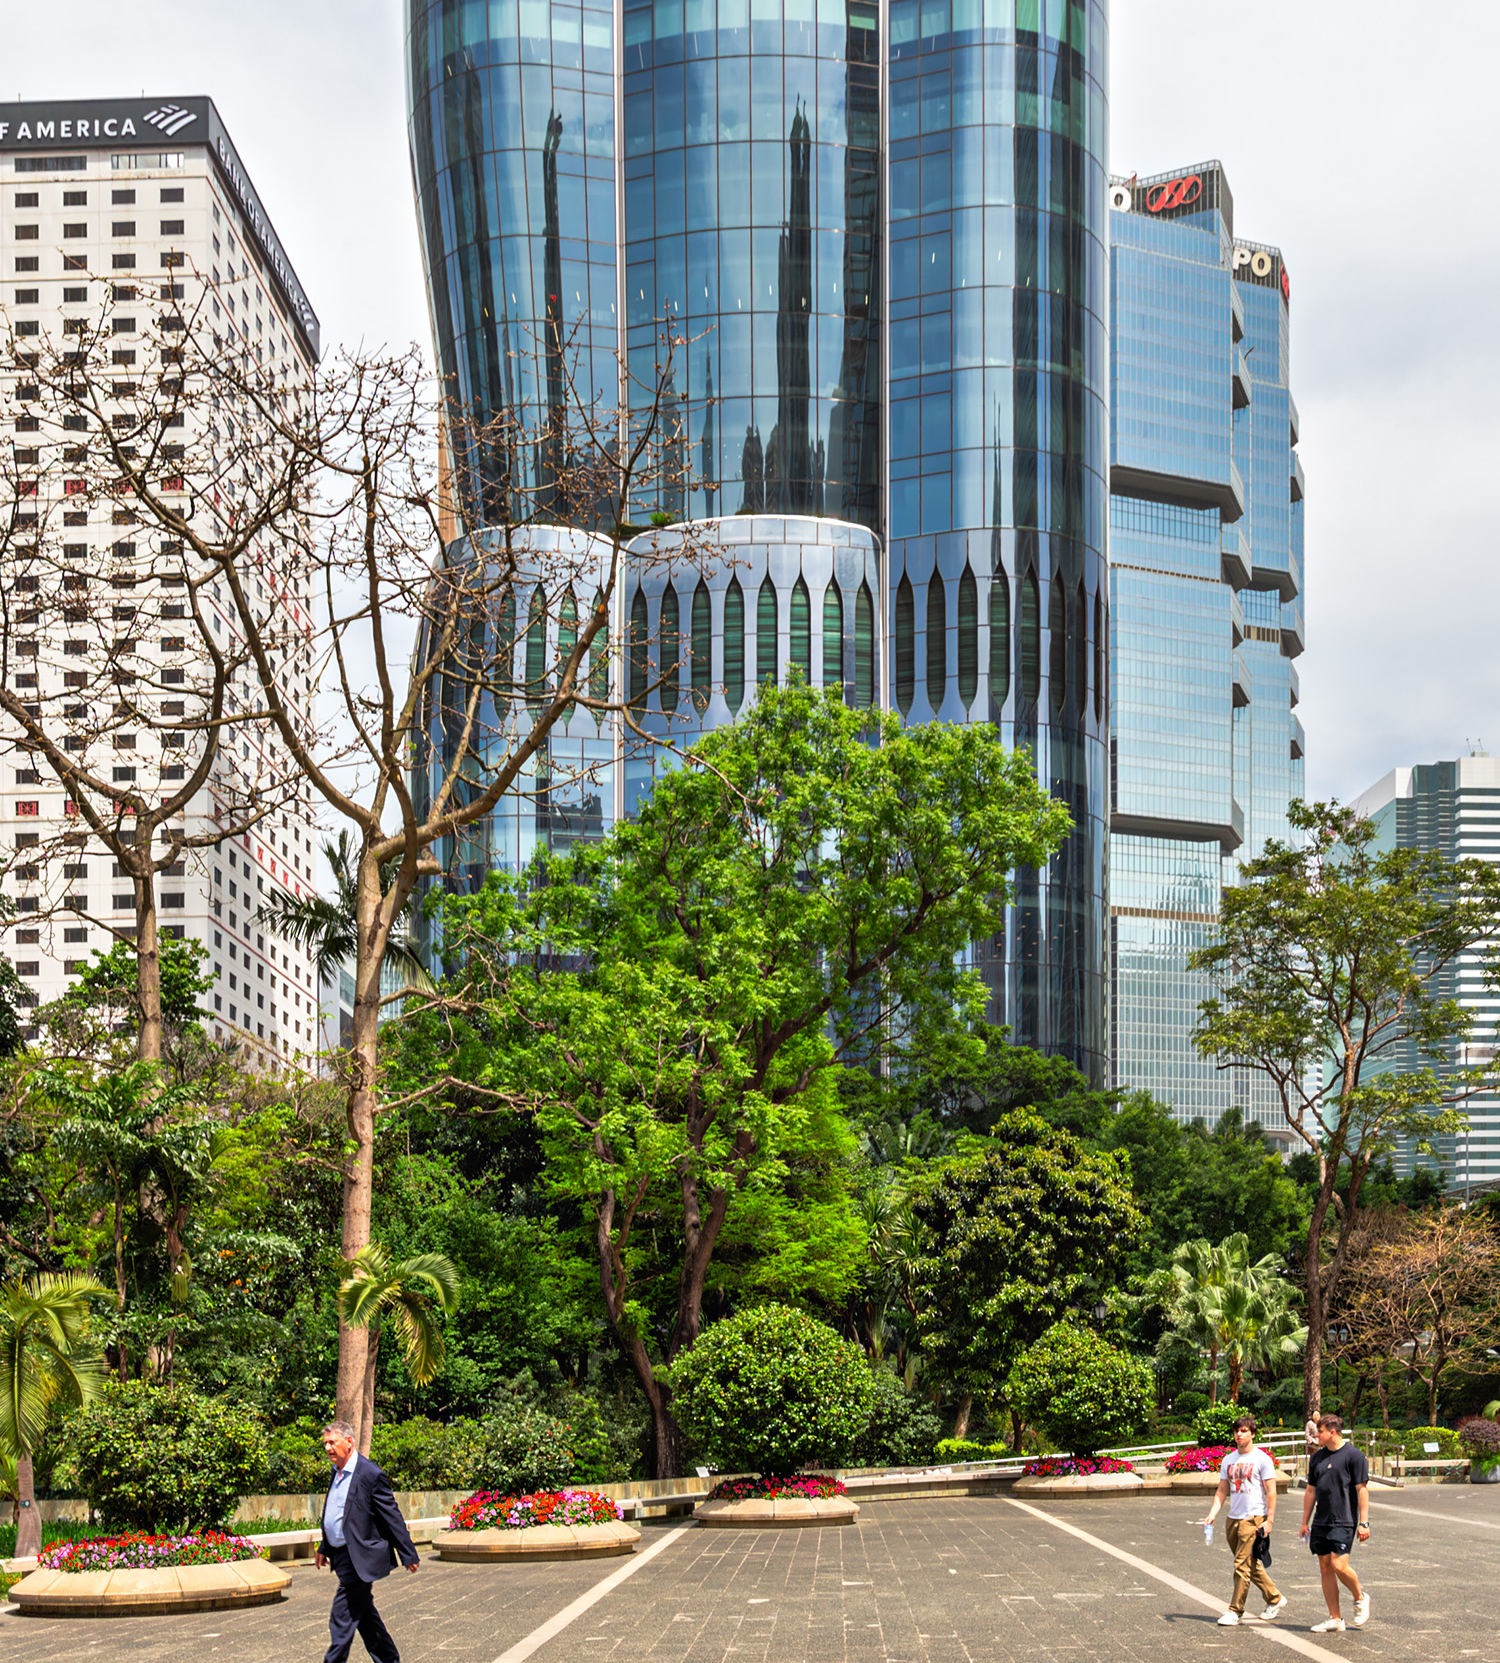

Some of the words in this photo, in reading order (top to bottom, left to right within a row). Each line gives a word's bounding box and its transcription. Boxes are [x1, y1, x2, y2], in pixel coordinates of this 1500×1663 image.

[16, 118, 137, 140] AMERICA
[219, 137, 246, 206] BANK
[247, 198, 260, 229] OF
[260, 225, 299, 311] AMERICA
